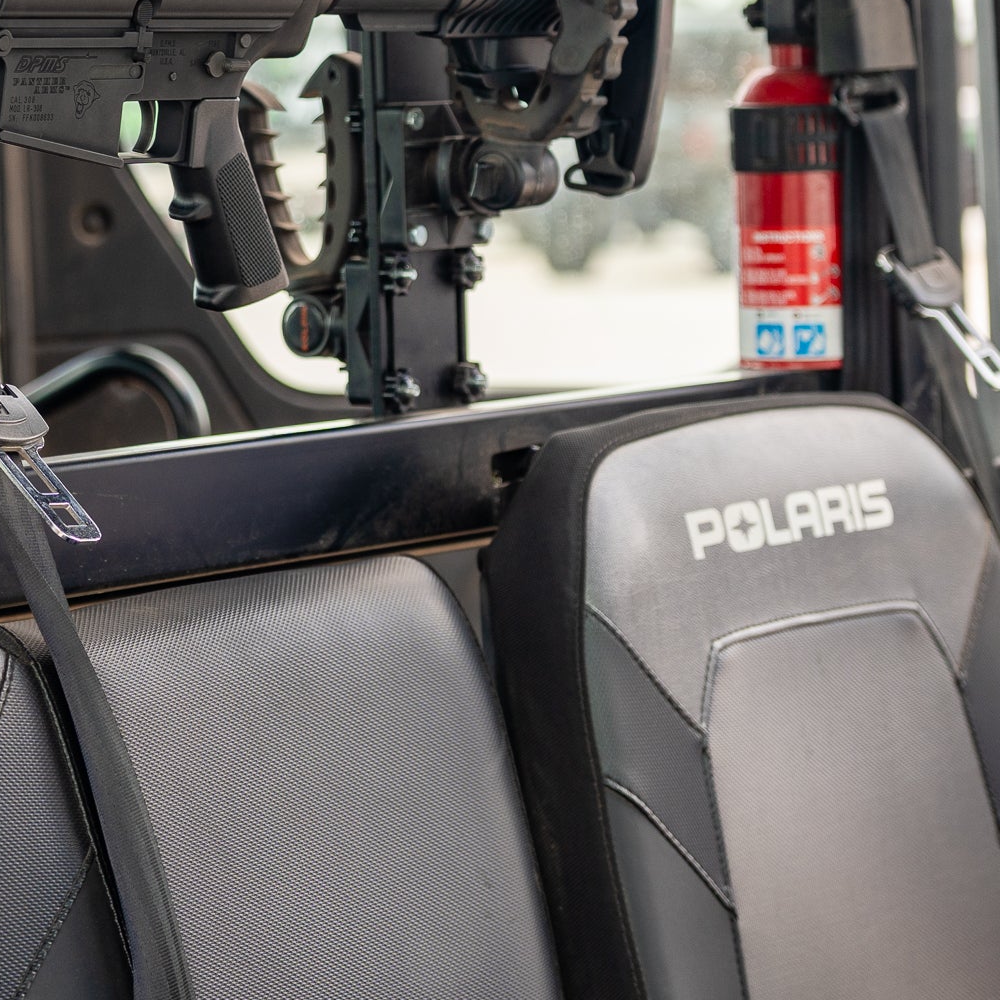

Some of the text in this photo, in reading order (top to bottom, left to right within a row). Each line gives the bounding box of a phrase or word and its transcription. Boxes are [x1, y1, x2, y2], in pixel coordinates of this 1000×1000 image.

[14, 55, 69, 73] DPMS
[12, 77, 66, 86] PANTHER
[684, 478, 895, 560] POLARIS
